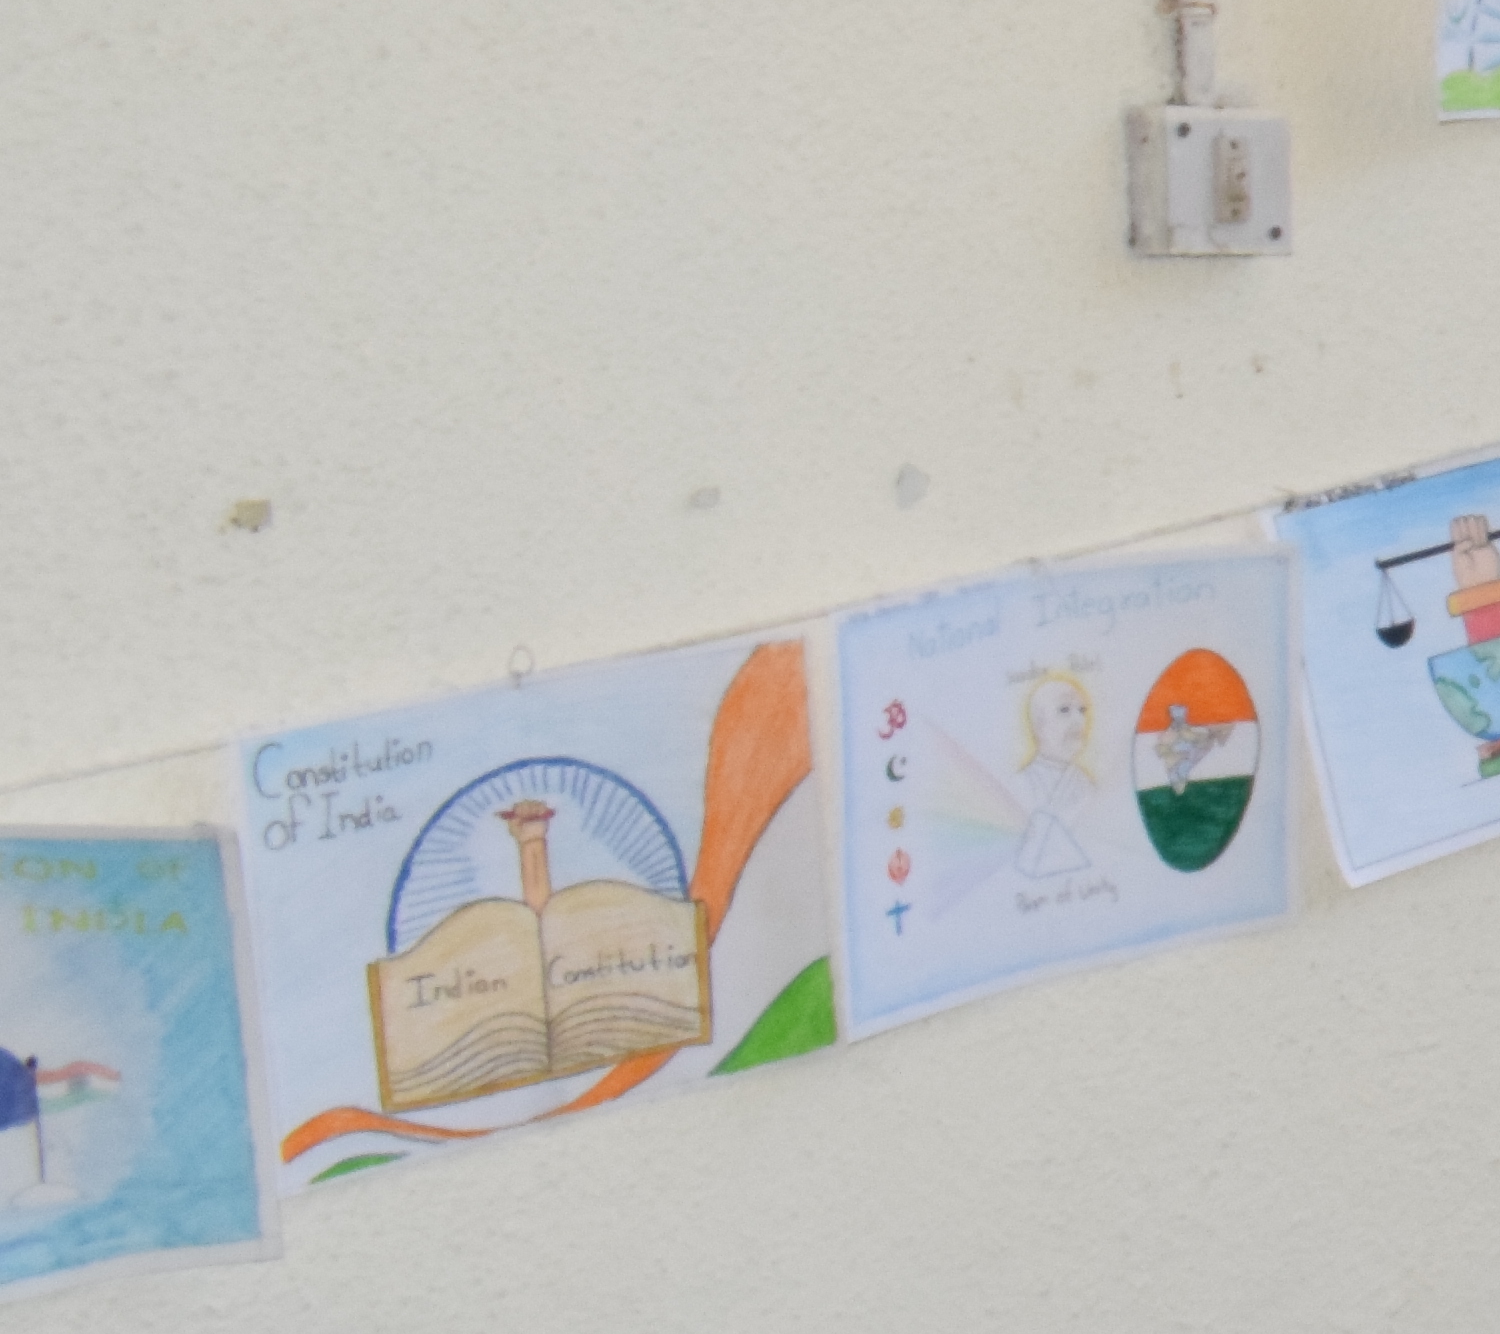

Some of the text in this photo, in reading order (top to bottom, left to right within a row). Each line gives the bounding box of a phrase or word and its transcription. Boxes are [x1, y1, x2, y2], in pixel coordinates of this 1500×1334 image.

[253, 740, 434, 799] Constitution
[264, 790, 402, 851] of India
[406, 968, 508, 1009] Indian
